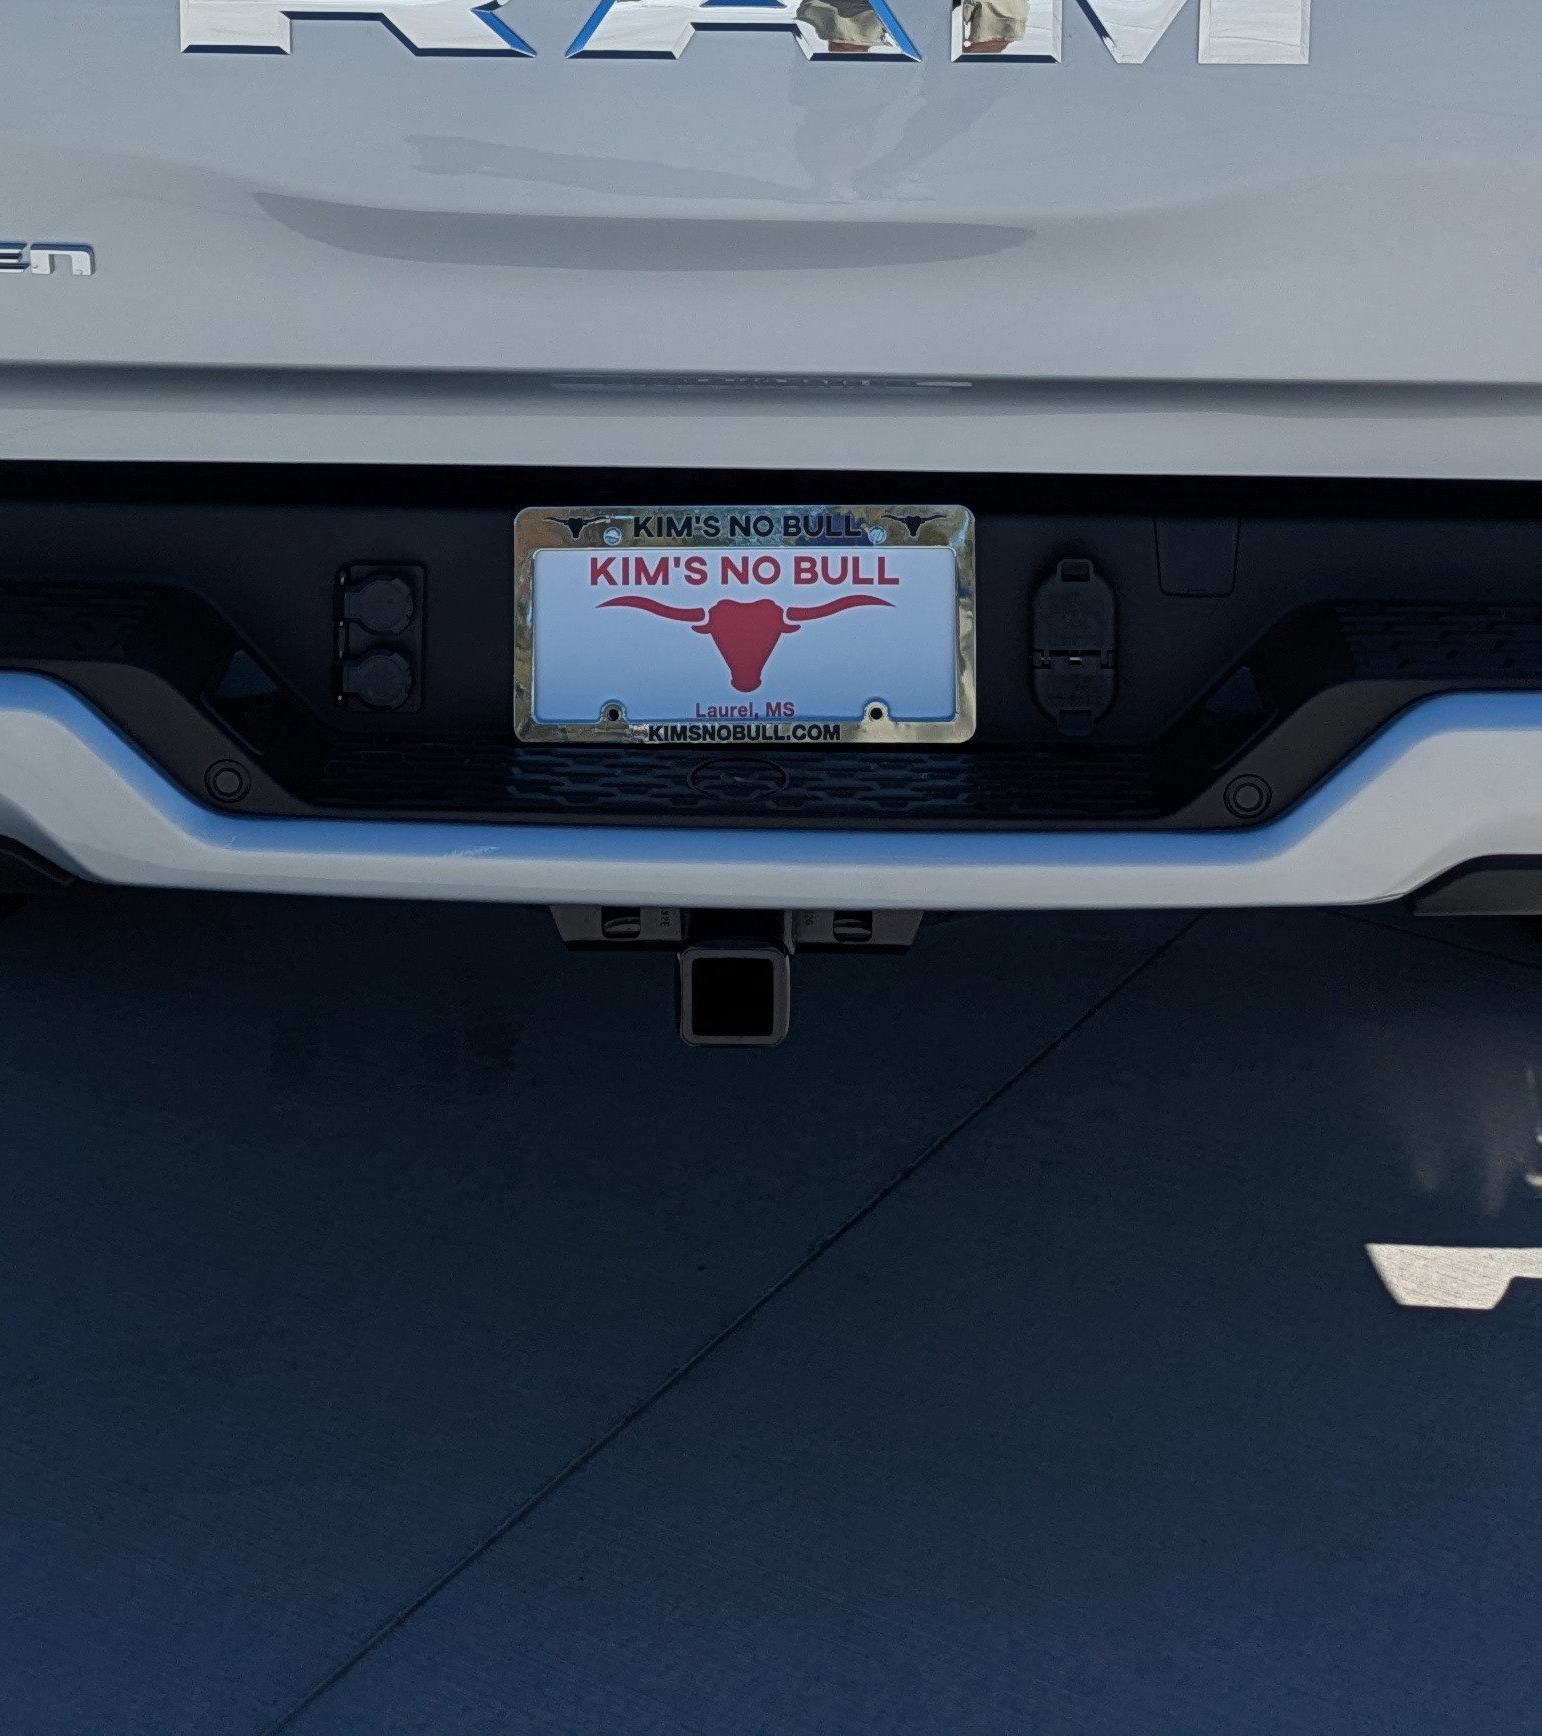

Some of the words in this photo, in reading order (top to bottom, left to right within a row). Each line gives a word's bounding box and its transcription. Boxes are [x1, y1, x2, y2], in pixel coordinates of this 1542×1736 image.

[632, 515, 720, 539] KIM'S
[728, 515, 775, 539] NO
[782, 515, 862, 539] BULL
[589, 555, 708, 586] KIM'S
[720, 554, 782, 586] NO
[793, 555, 900, 586] BULL
[695, 702, 759, 721] Laurel,
[765, 701, 796, 718] MS
[647, 724, 842, 742] KIMSNOBULL.COM
